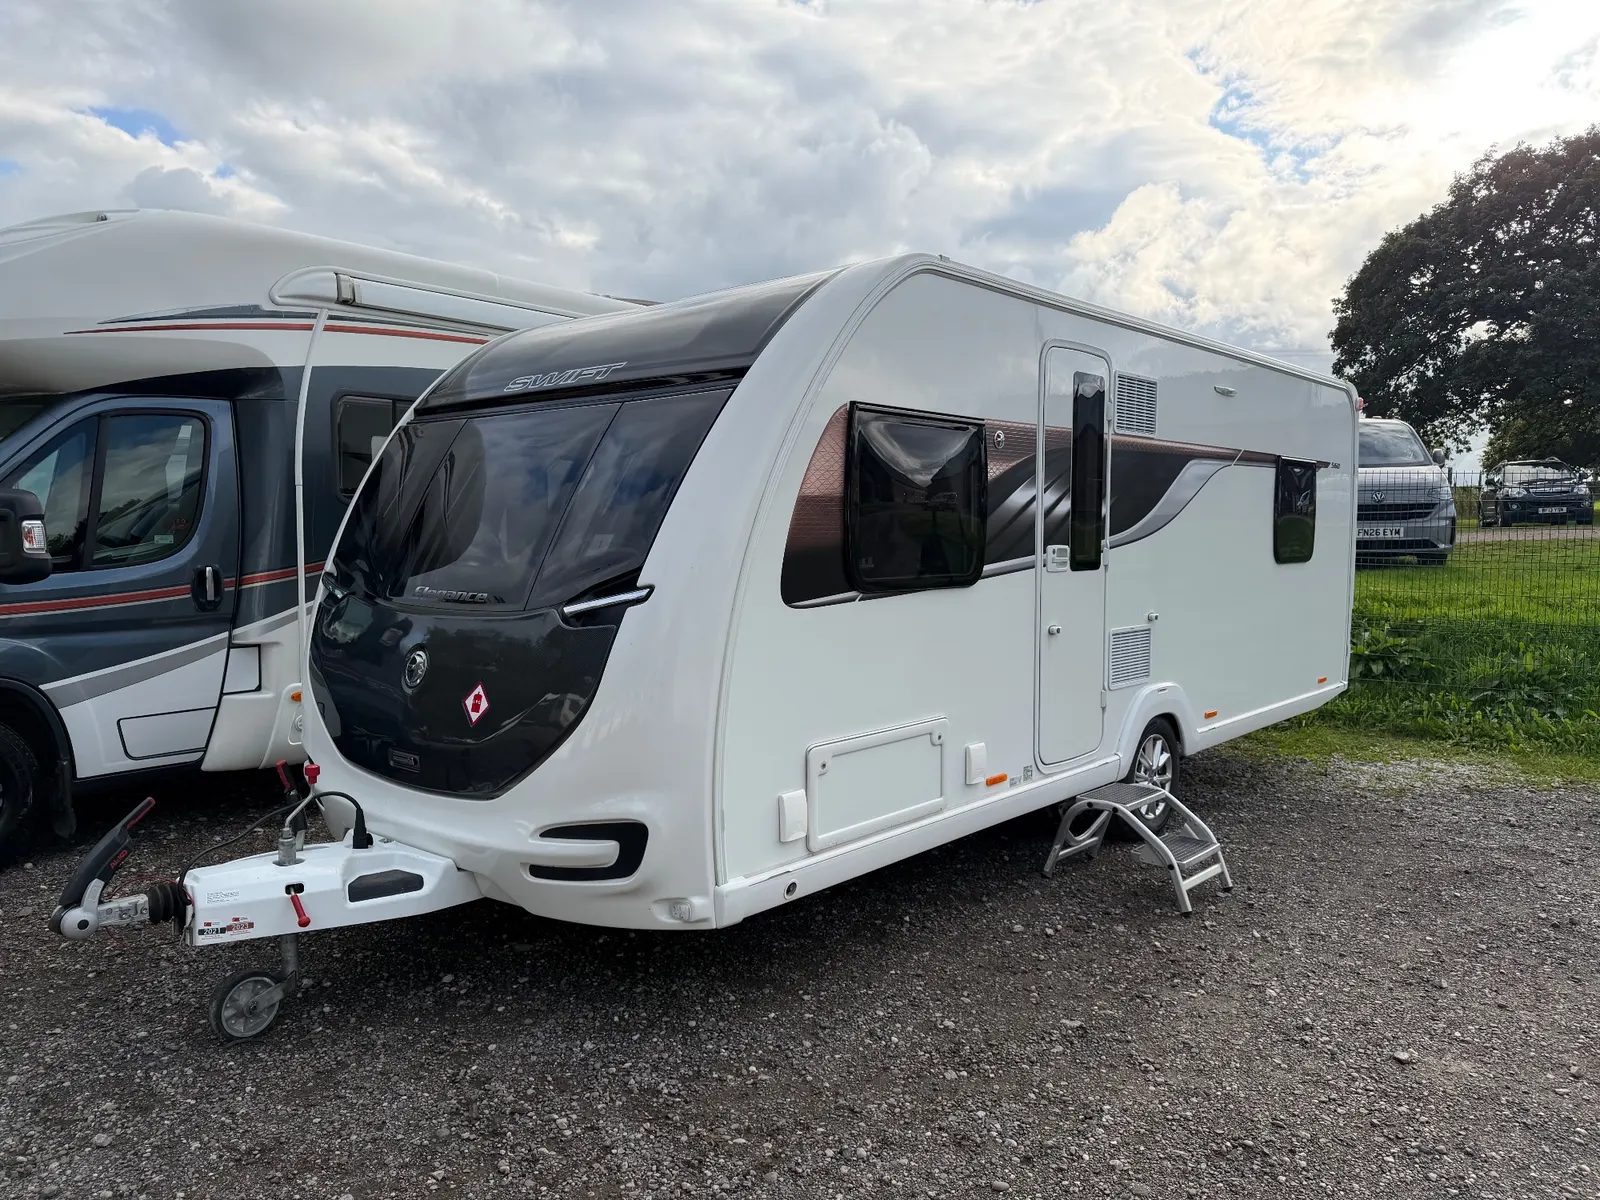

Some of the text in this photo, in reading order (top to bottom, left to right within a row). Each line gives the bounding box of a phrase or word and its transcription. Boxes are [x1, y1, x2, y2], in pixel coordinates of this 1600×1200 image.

[503, 361, 628, 392] SWIFT
[1357, 528, 1400, 537] FN26 EYM
[412, 585, 488, 603] Elegance
